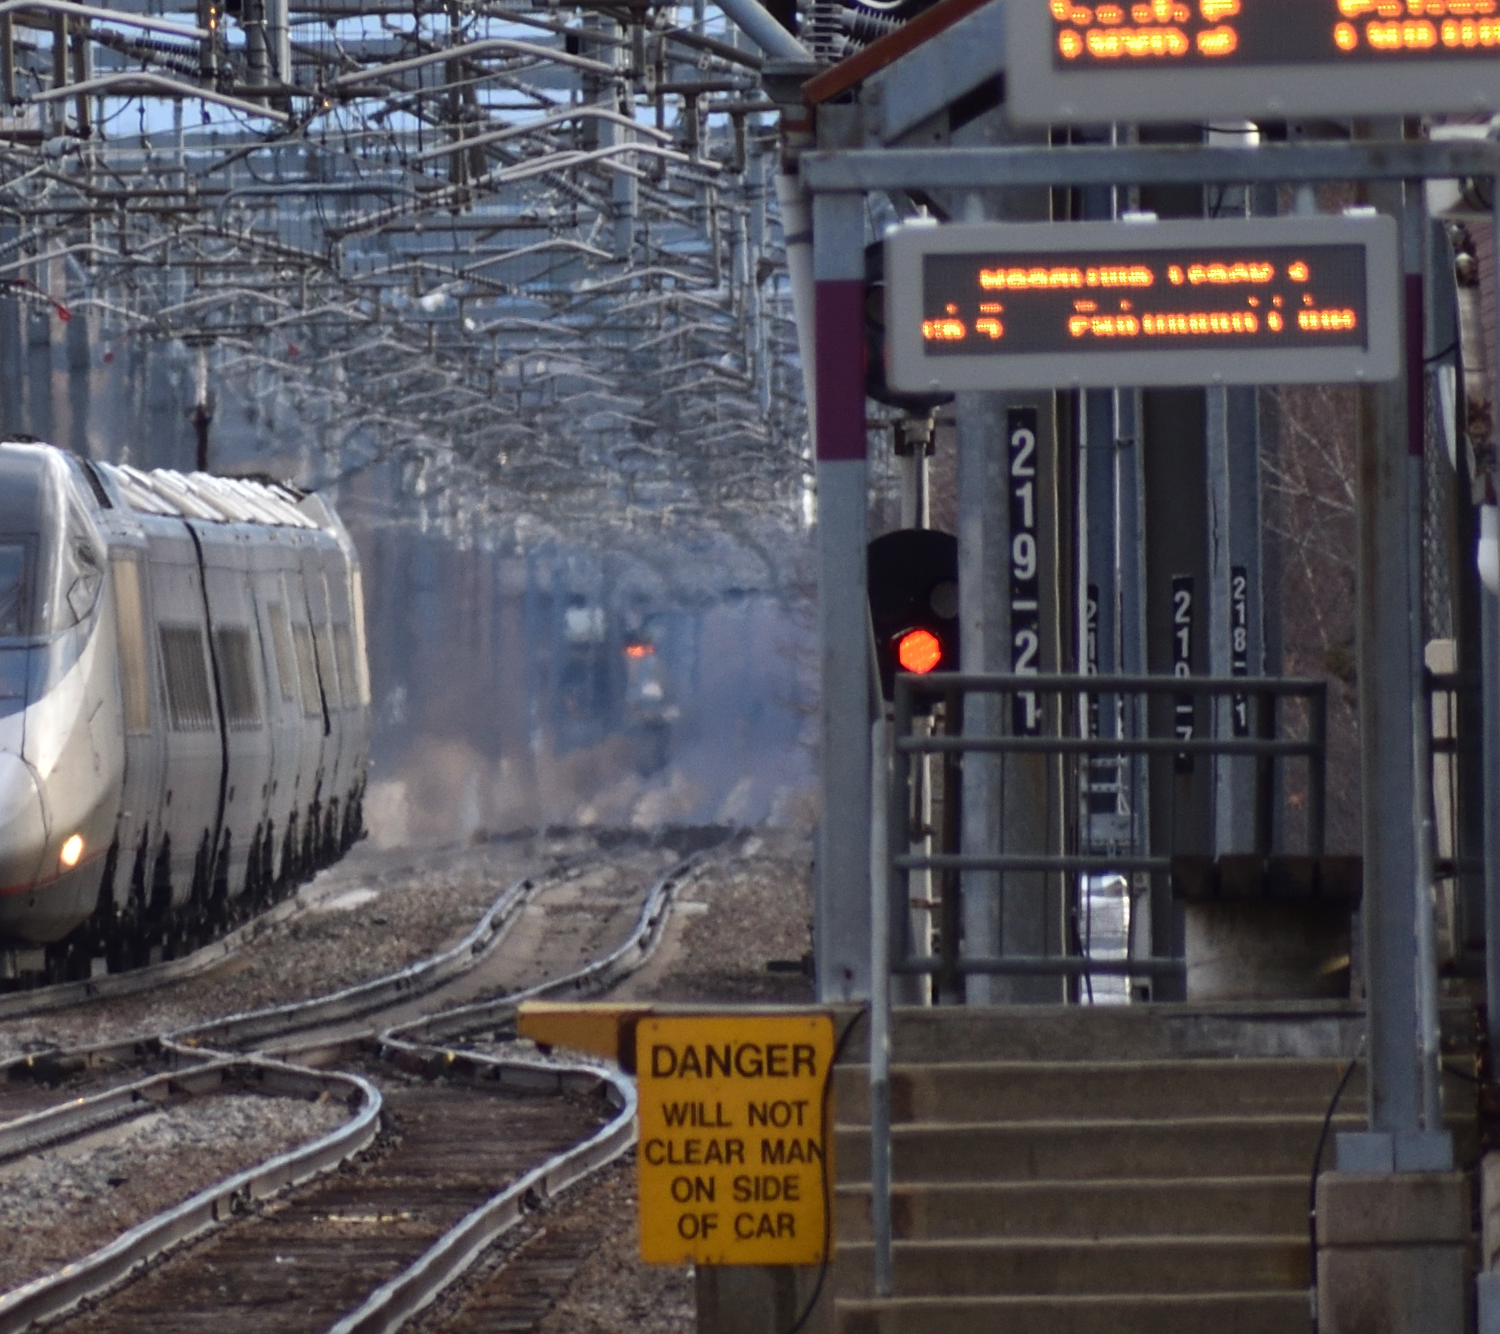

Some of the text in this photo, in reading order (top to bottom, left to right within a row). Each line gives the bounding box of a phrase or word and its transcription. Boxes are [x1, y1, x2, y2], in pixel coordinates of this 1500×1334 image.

[1011, 428, 1040, 729] 219-21
[1233, 577, 1247, 727] 218-1
[651, 1043, 817, 1079] DANGER
[663, 1100, 809, 1128] WILL NOT
[645, 1139, 824, 1166] CLEAR MAN
[671, 1176, 800, 1203] ON SIDE
[678, 1213, 795, 1240] OF CAR
